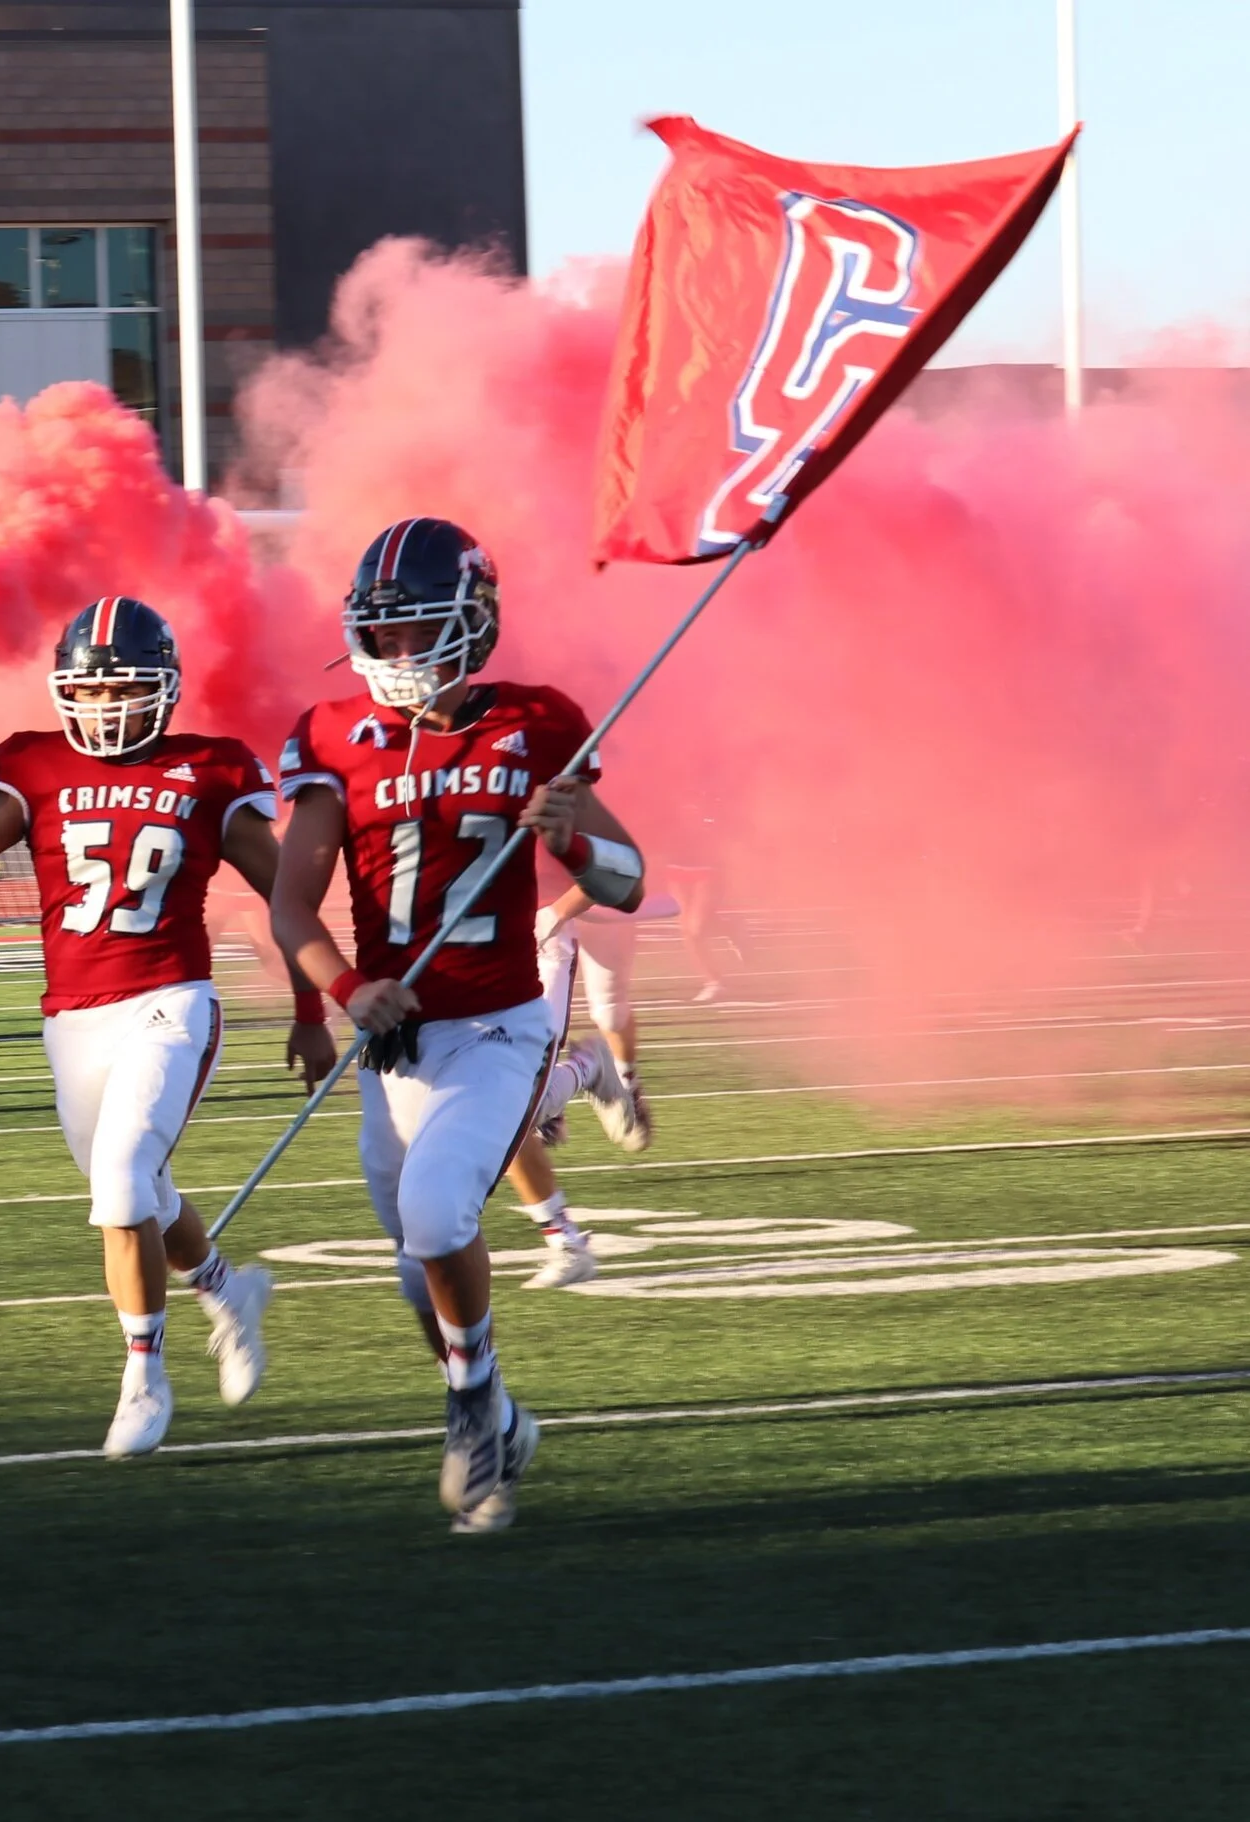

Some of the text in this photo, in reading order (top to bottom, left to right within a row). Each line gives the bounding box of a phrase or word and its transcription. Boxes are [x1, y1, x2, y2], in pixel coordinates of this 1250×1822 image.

[58, 785, 198, 819] CRIMSON
[376, 766, 531, 810] CRIMSON
[59, 820, 186, 936] 59
[387, 812, 508, 946] 12
